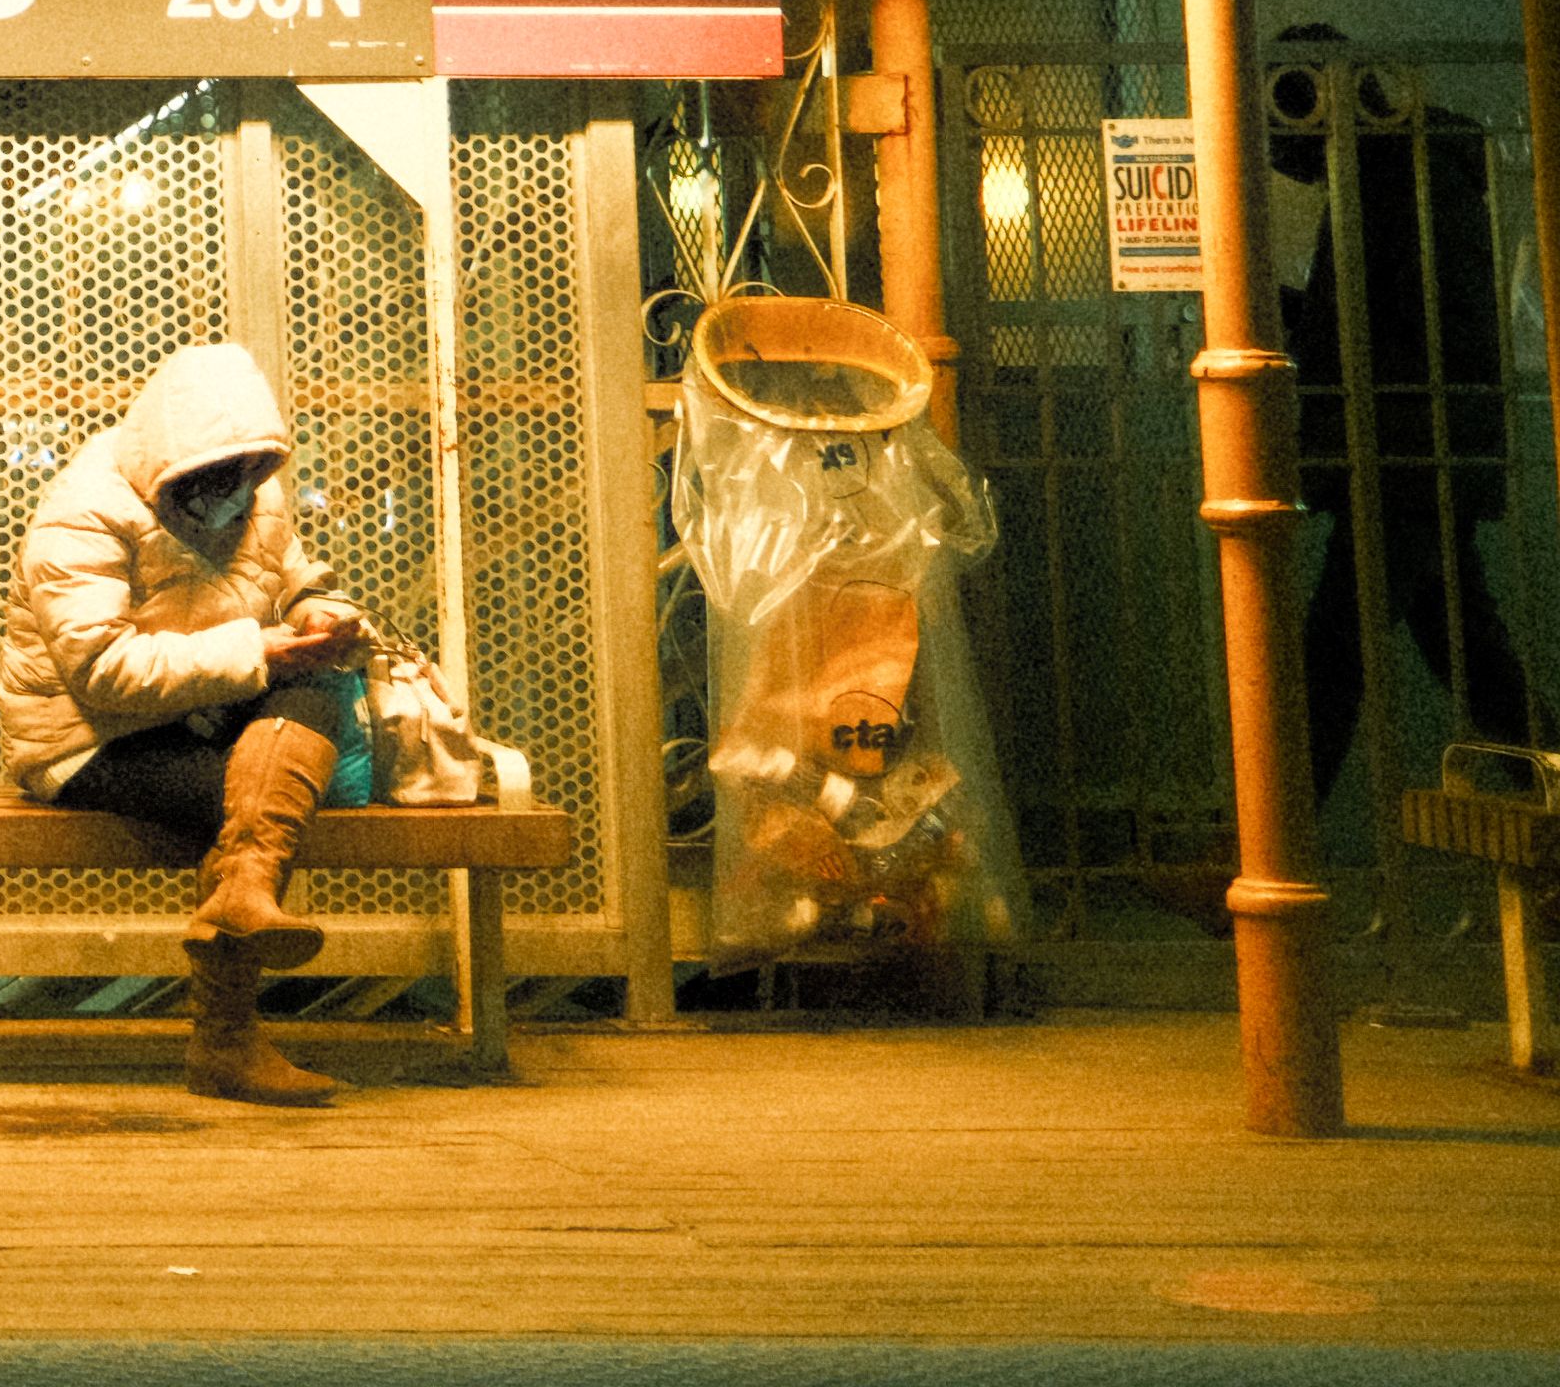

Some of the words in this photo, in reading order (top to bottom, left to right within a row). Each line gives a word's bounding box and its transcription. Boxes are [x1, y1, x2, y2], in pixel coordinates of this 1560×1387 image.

[1115, 201, 1200, 218] PREVENTIO
[1116, 217, 1198, 233] LIFELIN
[832, 718, 895, 750] cta
